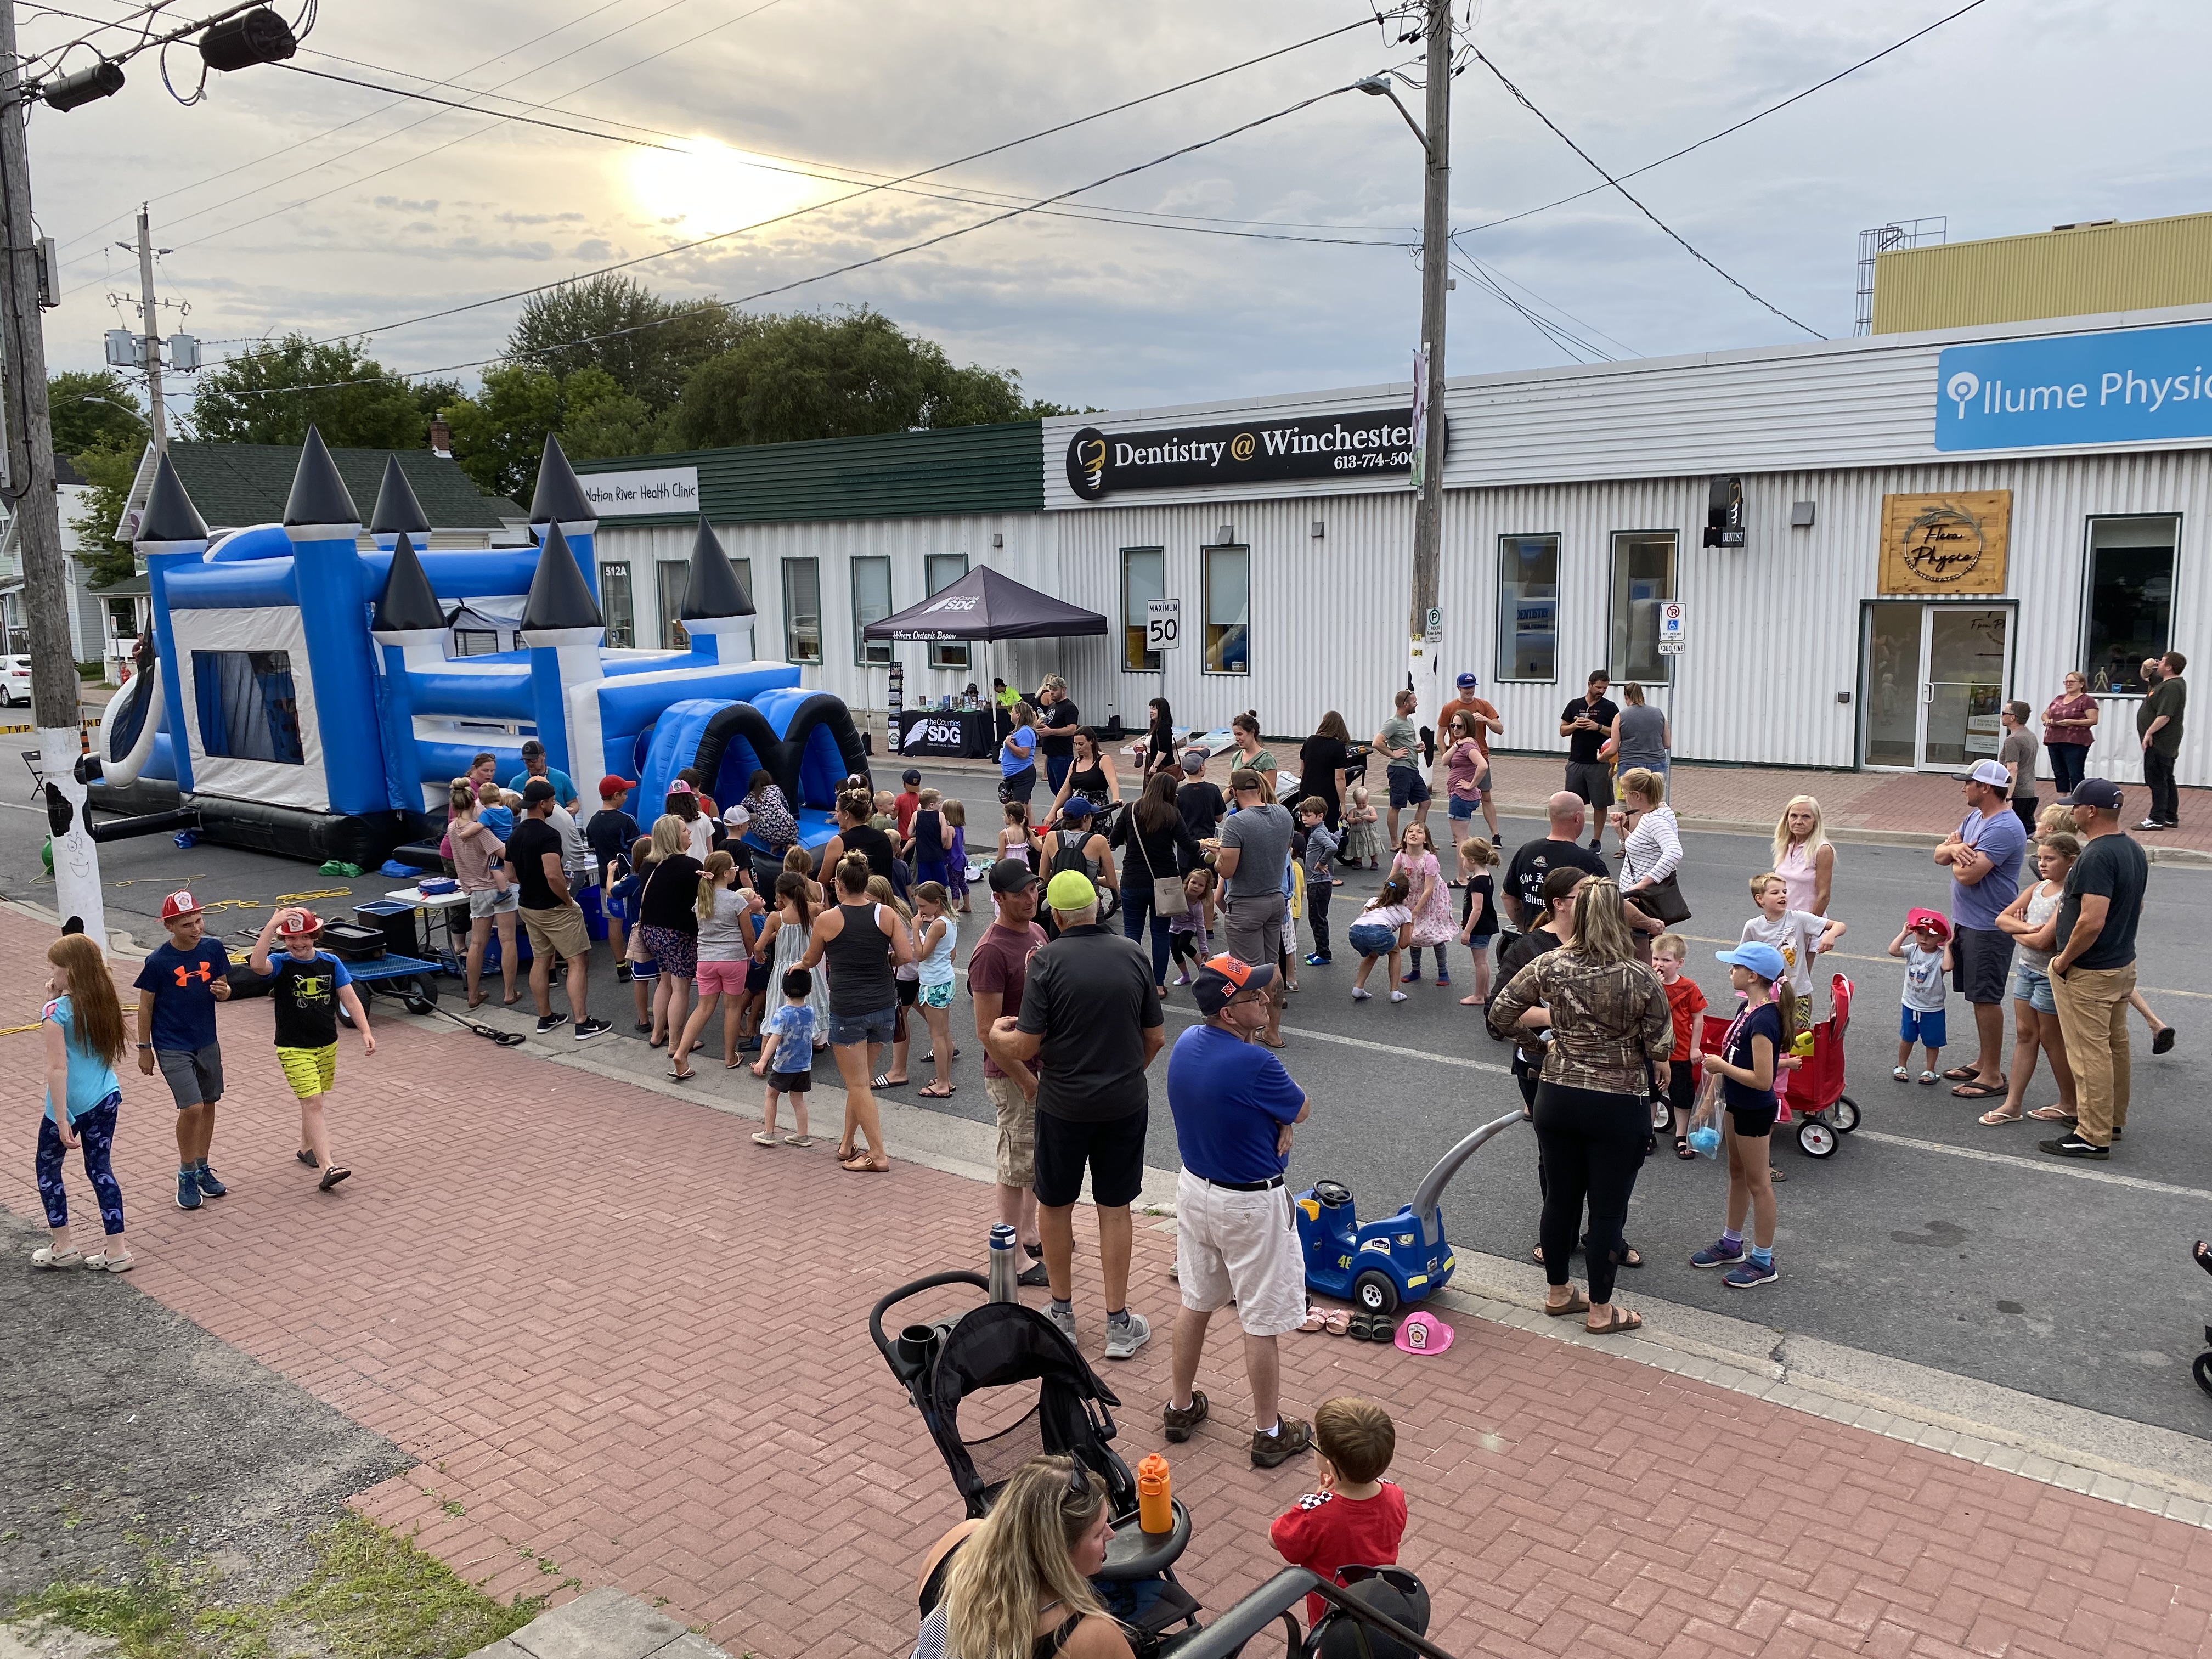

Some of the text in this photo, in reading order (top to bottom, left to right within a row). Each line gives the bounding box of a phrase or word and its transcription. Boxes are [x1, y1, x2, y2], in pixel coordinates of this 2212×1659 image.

[1114, 437, 1226, 467] Dentistry
[1231, 433, 1256, 461] @
[585, 481, 696, 503] Nation River Health Clinic
[1723, 532, 1743, 542] DENTIST
[1923, 523, 1963, 544] Flora
[1911, 545, 1973, 573] Physio
[605, 566, 627, 577] 512A
[944, 600, 976, 610] SDG
[1149, 603, 1178, 612] MAXIMUM
[893, 629, 912, 640] Where
[913, 630, 936, 640] Ontario
[1150, 619, 1177, 642] 50
[7, 725, 30, 734] TWP
[927, 725, 961, 743] SDG
[1520, 873, 1532, 884] The
[1338, 1255, 1353, 1269] 48
